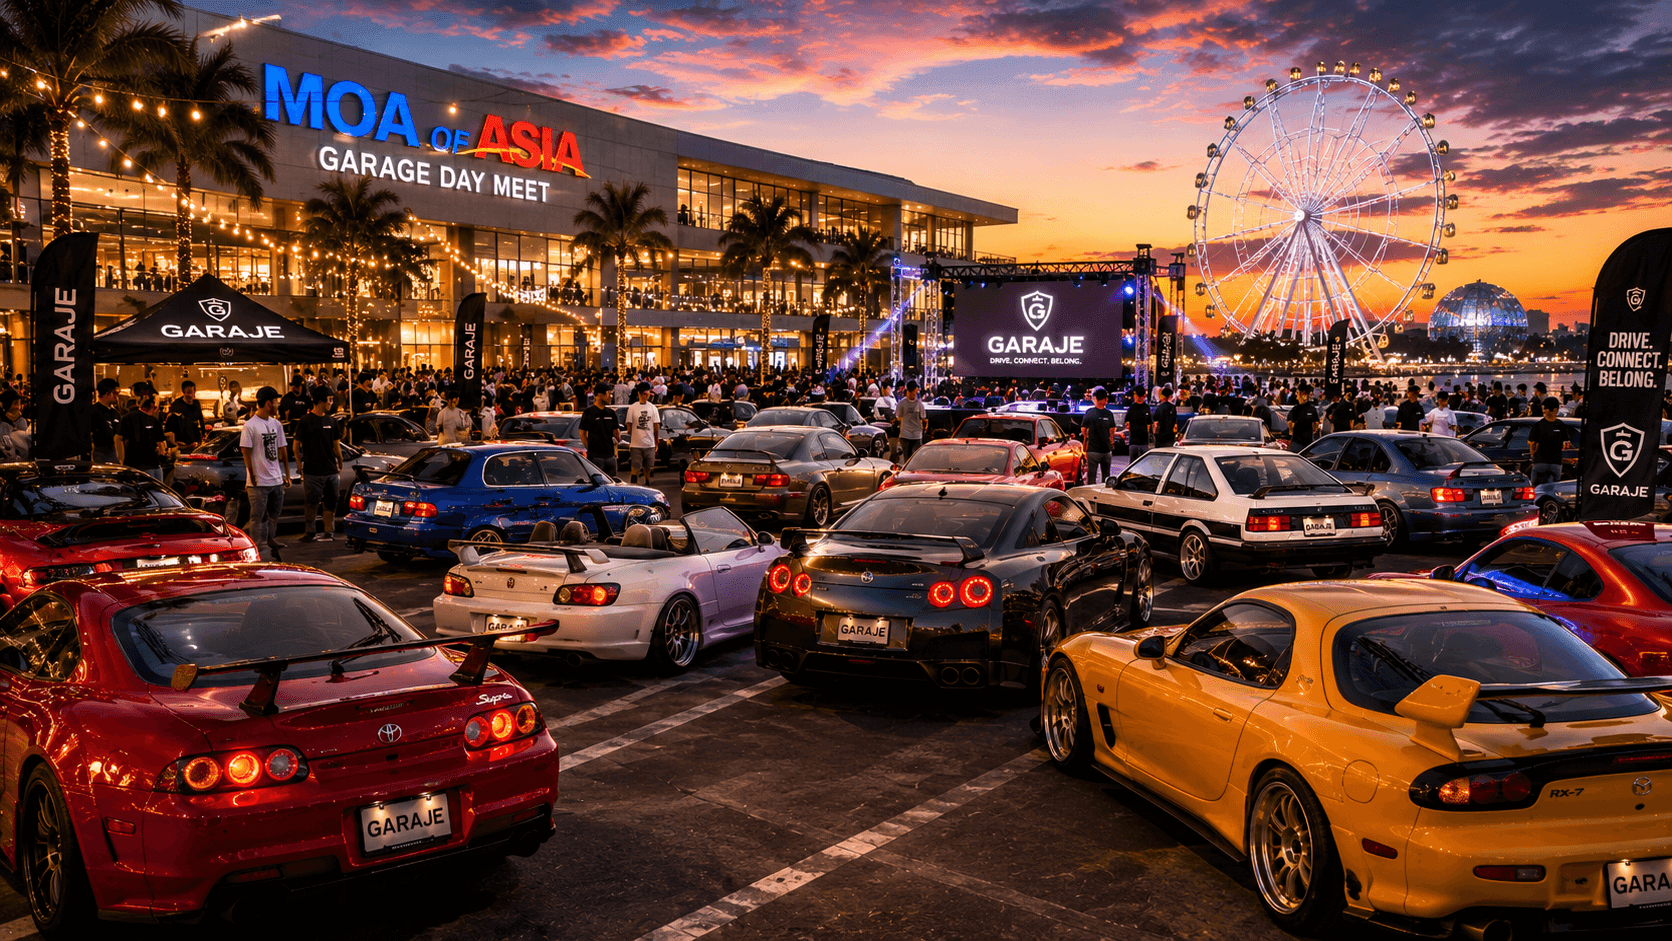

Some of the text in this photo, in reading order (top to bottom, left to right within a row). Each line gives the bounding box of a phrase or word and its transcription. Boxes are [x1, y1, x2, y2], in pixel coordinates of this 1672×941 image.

[264, 62, 591, 179] MOA OF ASIA
[319, 146, 551, 203] GARAGE DAY MEET
[160, 324, 286, 340] GARAJE
[1608, 331, 1654, 349] DRIVE.
[53, 287, 77, 405] GARAJE
[463, 322, 477, 380] GARAJE
[987, 336, 1086, 354] GARAJE
[1596, 351, 1663, 370] CONNECT.
[1598, 370, 1658, 389] BELONG.
[1589, 483, 1650, 498] GARAJE
[840, 624, 887, 638] GARAJE
[1549, 787, 1586, 799] RX-7
[366, 807, 445, 838] GARAJE
